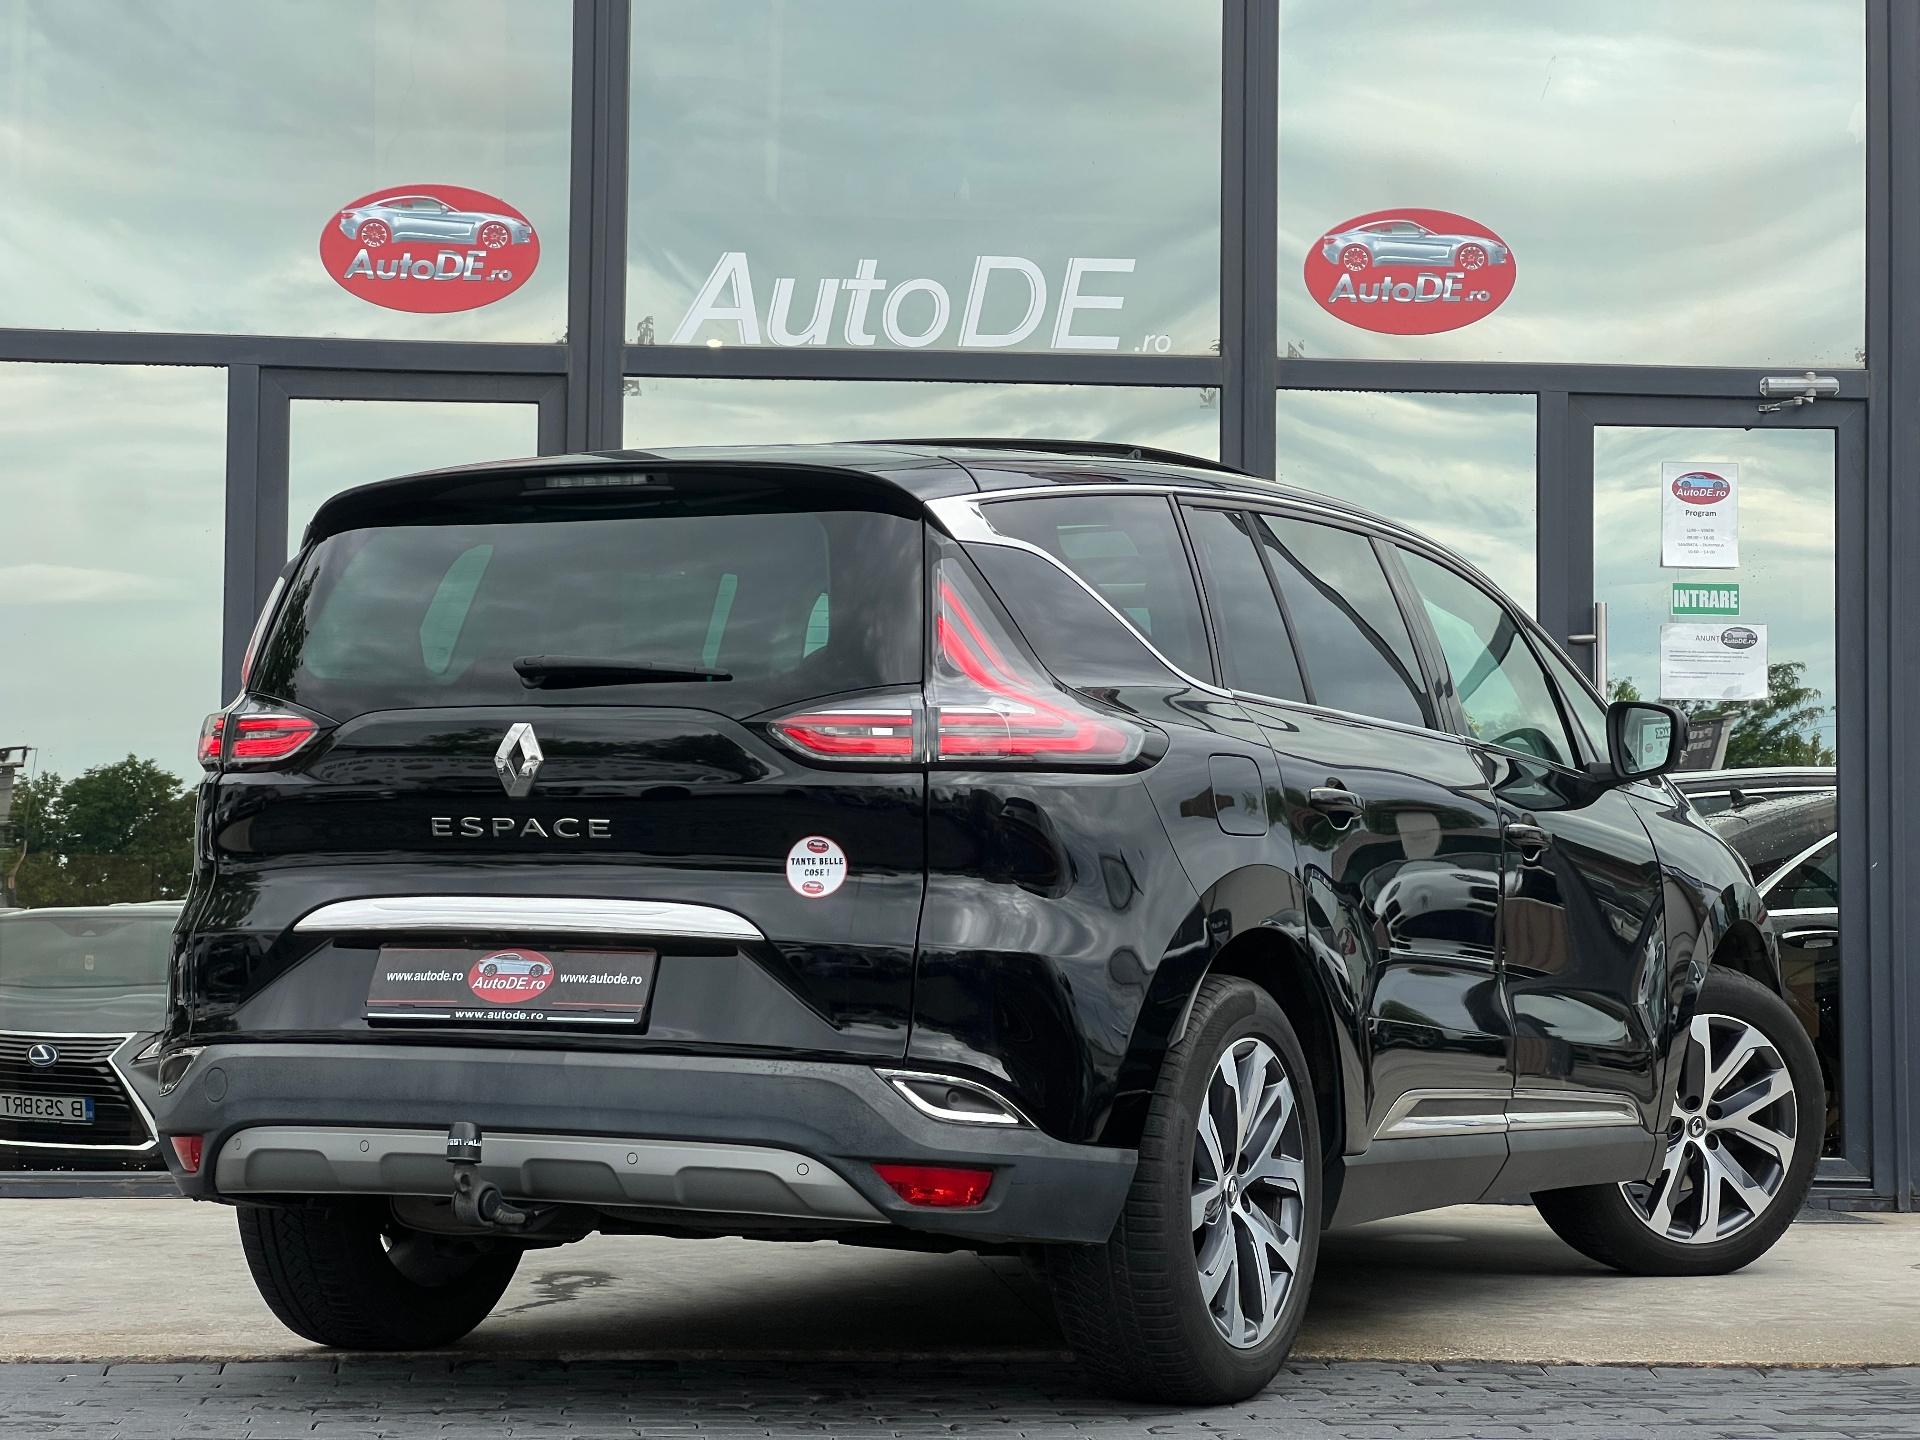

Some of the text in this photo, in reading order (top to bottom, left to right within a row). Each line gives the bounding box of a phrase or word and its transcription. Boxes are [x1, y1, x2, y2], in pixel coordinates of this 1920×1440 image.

[1676, 488, 1727, 497] AutoDE.ro
[1685, 509, 1717, 517] Program
[1673, 589, 1738, 608] INTRARE
[431, 816, 612, 839] ESPACE
[791, 857, 844, 865] TANTE BELLE
[804, 868, 825, 876] COSE
[386, 970, 464, 982] www.autode.ro
[560, 972, 643, 985] www.autode.ro
[471, 976, 547, 991] AutoDE.ro
[454, 1010, 544, 1021] www.autode.ro
